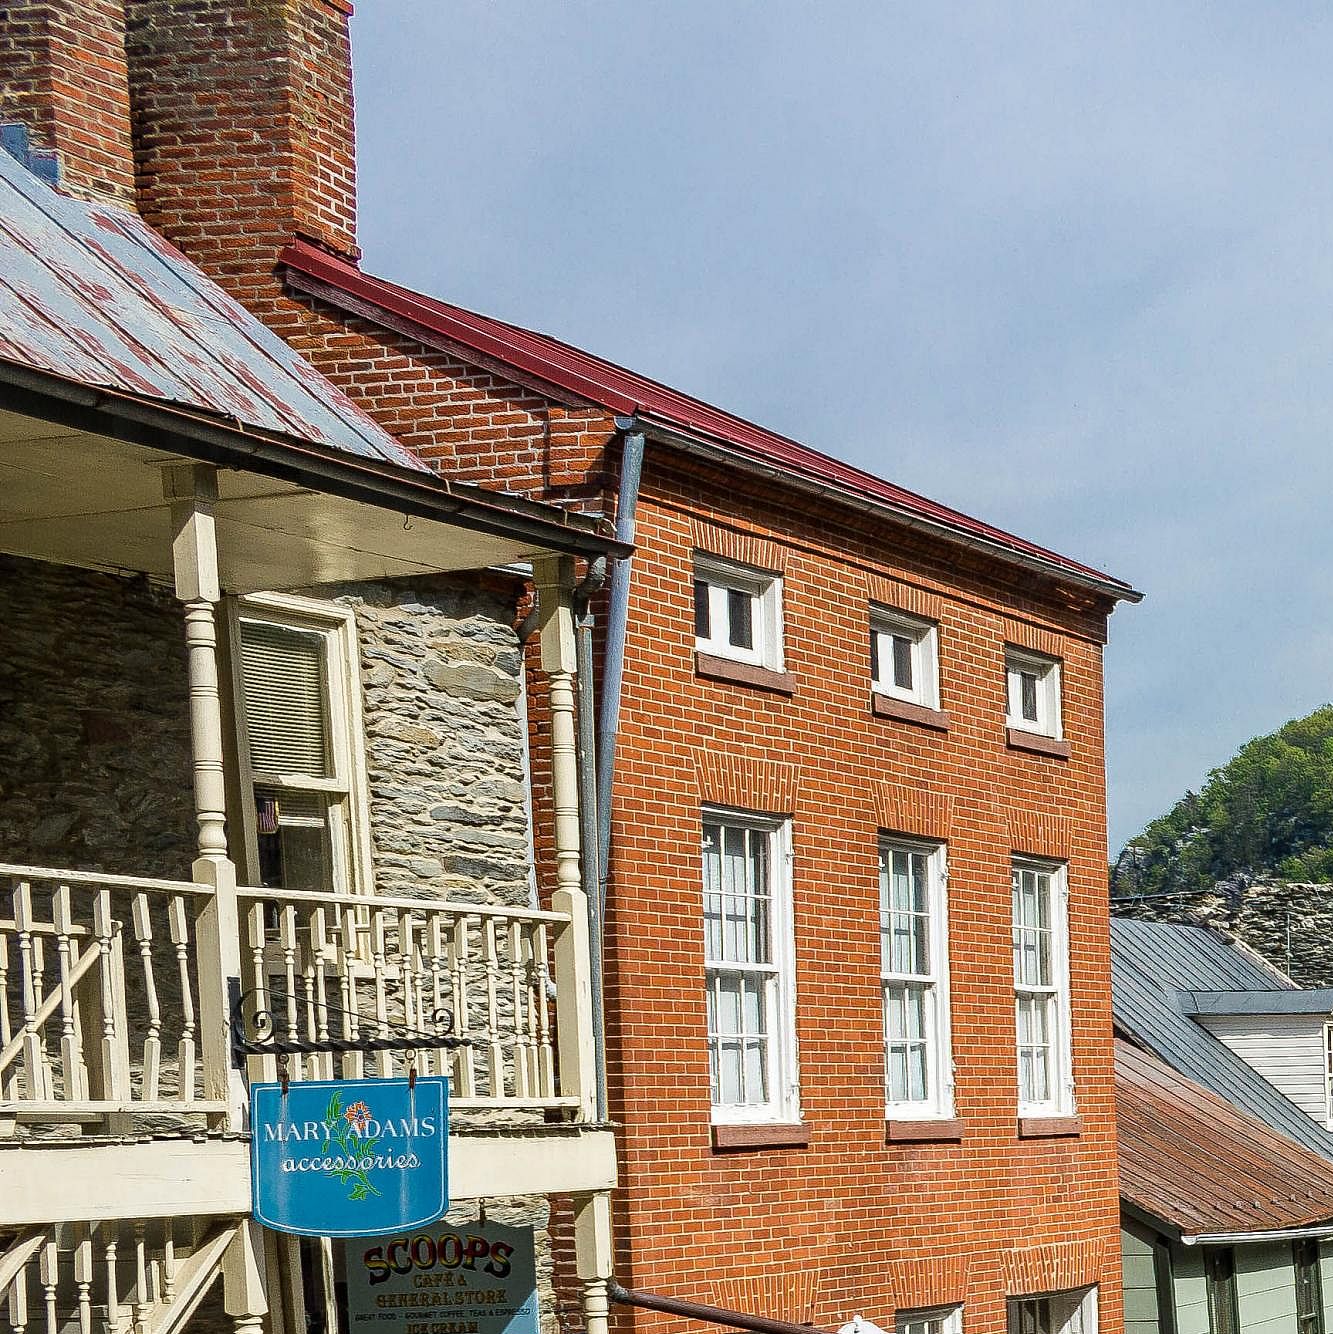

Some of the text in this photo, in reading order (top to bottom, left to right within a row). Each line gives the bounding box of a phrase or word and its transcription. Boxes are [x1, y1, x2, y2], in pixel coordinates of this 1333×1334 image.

[264, 1117, 436, 1142] MARY ADAMS
[282, 1148, 422, 1172] accessories
[364, 1233, 514, 1286] SCOOPS
[375, 1289, 508, 1308] GENERAL STORE
[430, 1321, 480, 1334] CREAM
